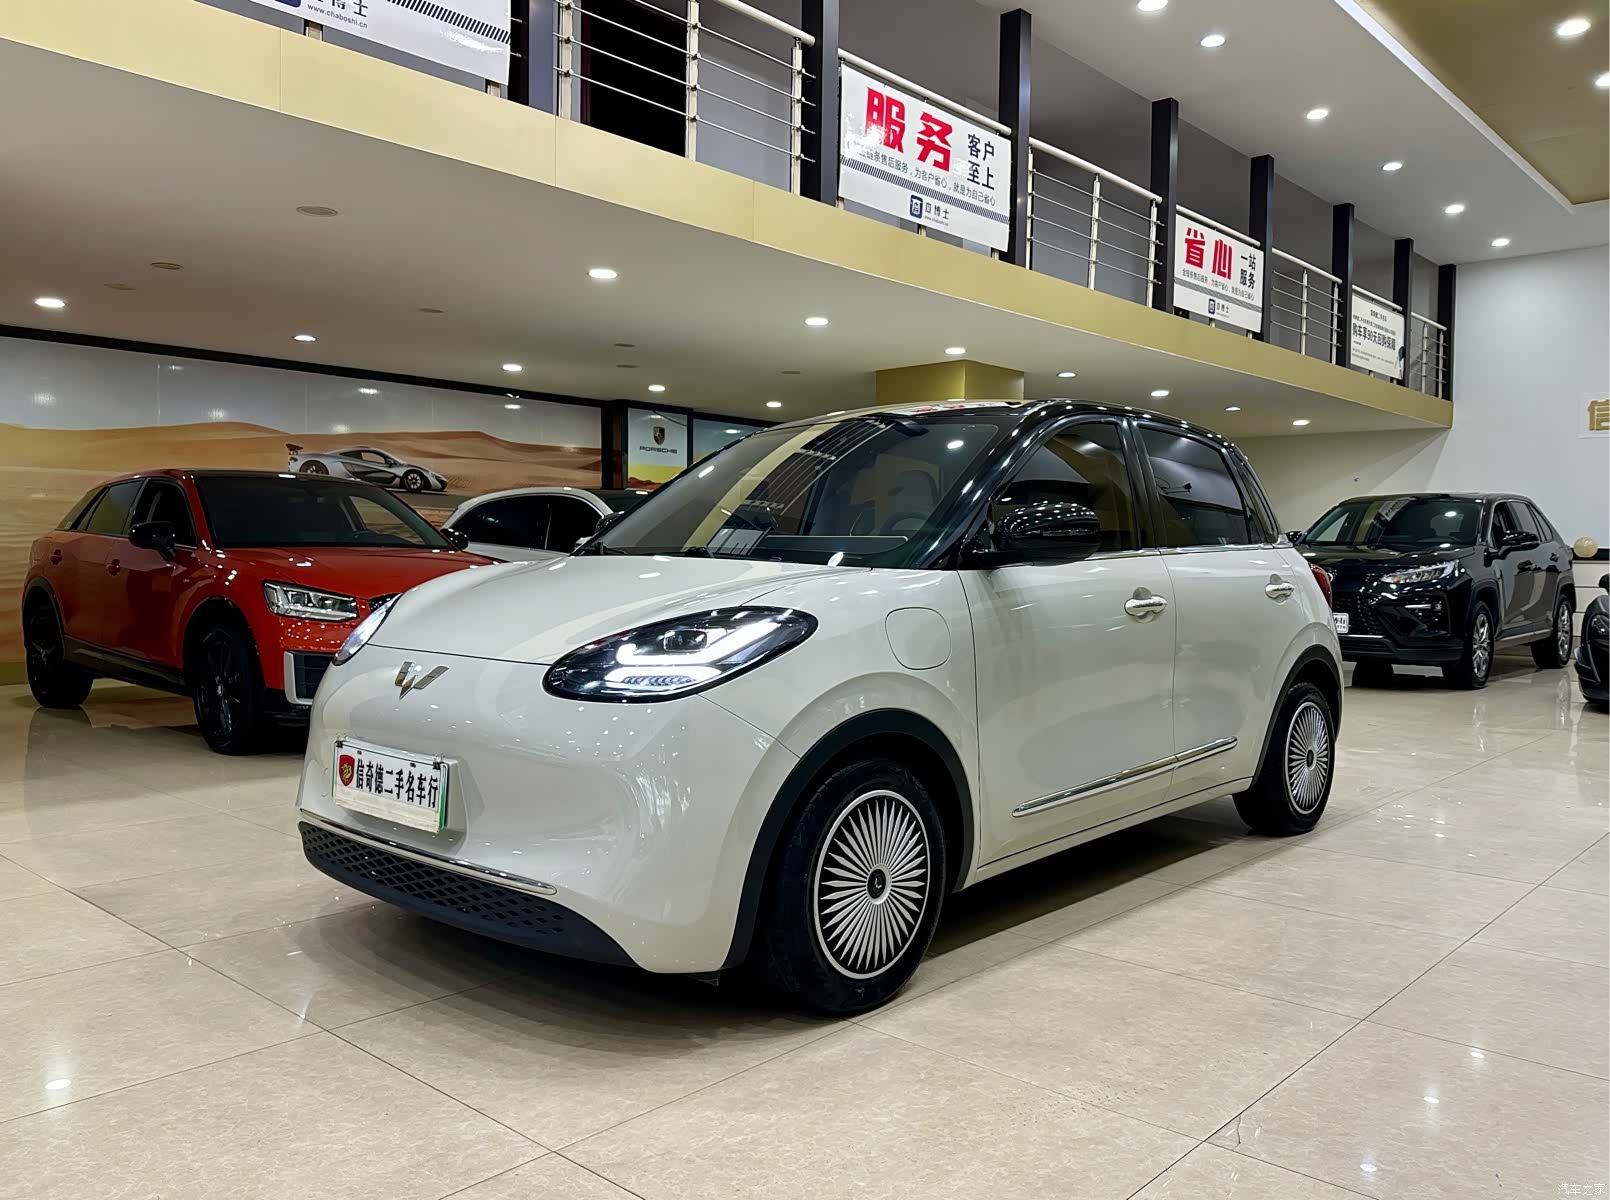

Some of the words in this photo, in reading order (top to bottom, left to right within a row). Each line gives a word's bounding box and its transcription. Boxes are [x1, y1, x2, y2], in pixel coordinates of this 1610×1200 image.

[307, 4, 368, 29] www.chaboshi.cn
[865, 86, 953, 172] 服务
[968, 133, 995, 161] 客户
[967, 160, 995, 190] 至上
[1185, 226, 1233, 280] 省心
[1240, 252, 1256, 271] 一站
[1239, 268, 1256, 290] 服务
[639, 445, 678, 455] PORSCHE
[356, 758, 438, 808] 信奇德二手名车行
